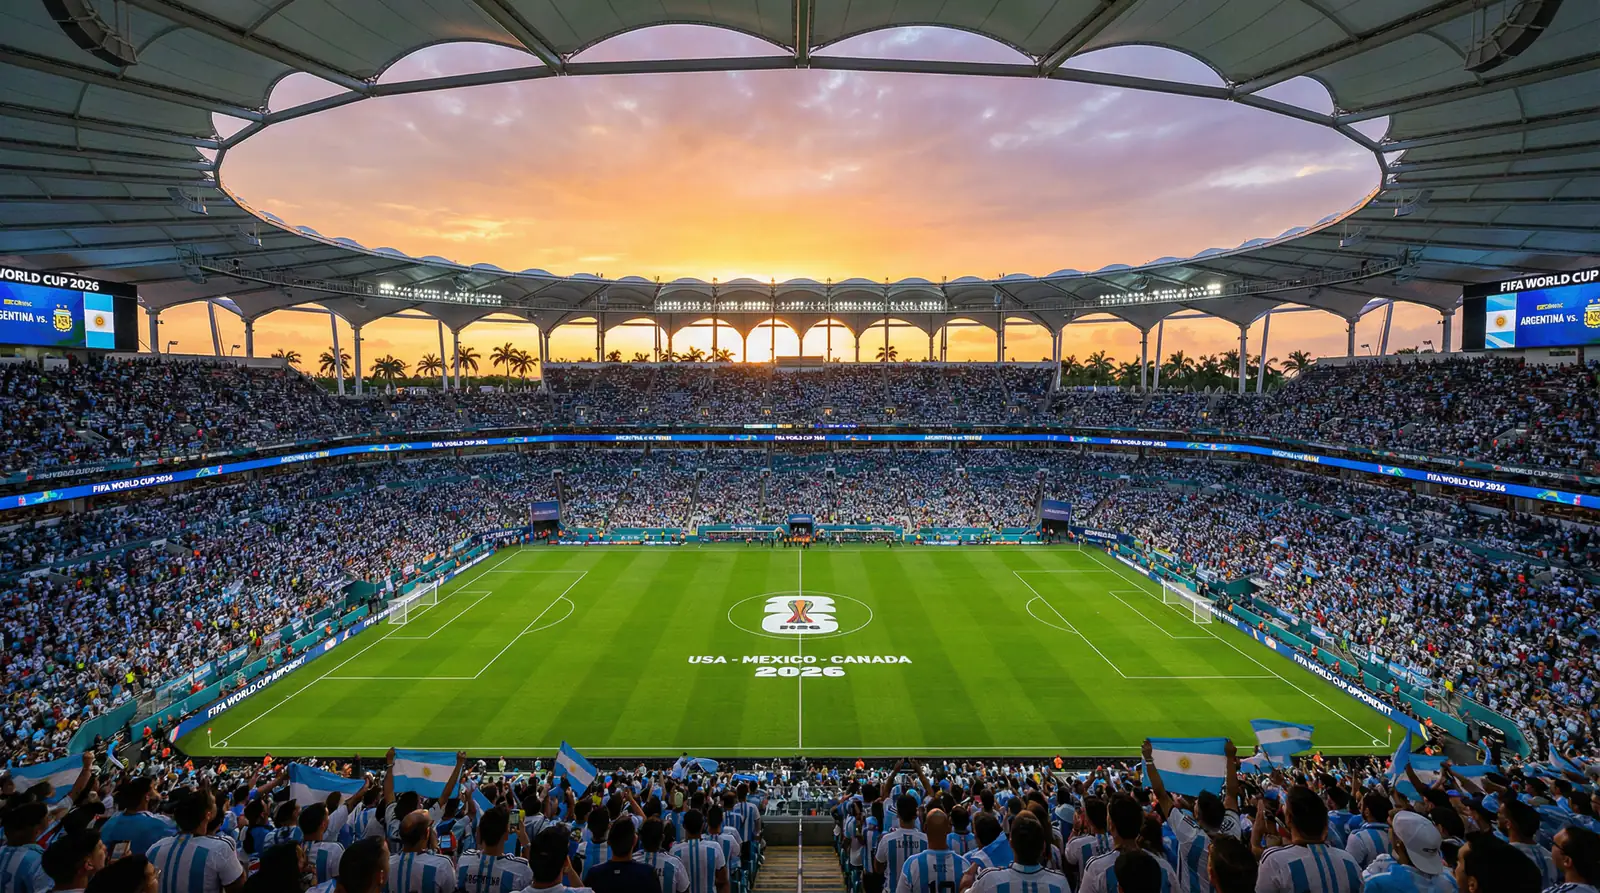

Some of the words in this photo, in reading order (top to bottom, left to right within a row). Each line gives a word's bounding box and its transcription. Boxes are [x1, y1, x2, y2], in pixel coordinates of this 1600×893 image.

[43, 275, 67, 287] CUP
[70, 278, 100, 291] 2026
[1500, 280, 1524, 292] FIFA
[1526, 274, 1570, 289] WORLD
[1571, 270, 1599, 282] CUP
[1520, 313, 1564, 326] ARGENTINA
[92, 484, 111, 493] FIFA
[111, 479, 139, 490] WORLD
[140, 477, 155, 486] CUP
[1441, 476, 1468, 486] WORLD
[1469, 480, 1485, 489] CUP
[1486, 482, 1506, 492] 2026
[688, 655, 727, 664] USA
[742, 655, 817, 664] MEXICO
[831, 655, 912, 664] CANADA
[754, 666, 846, 677] 2026
[1308, 661, 1332, 681] WORLD
[1333, 676, 1347, 689] CUP
[208, 702, 227, 718] FIFA
[227, 684, 256, 706] WORLD
[257, 676, 272, 688] CUP
